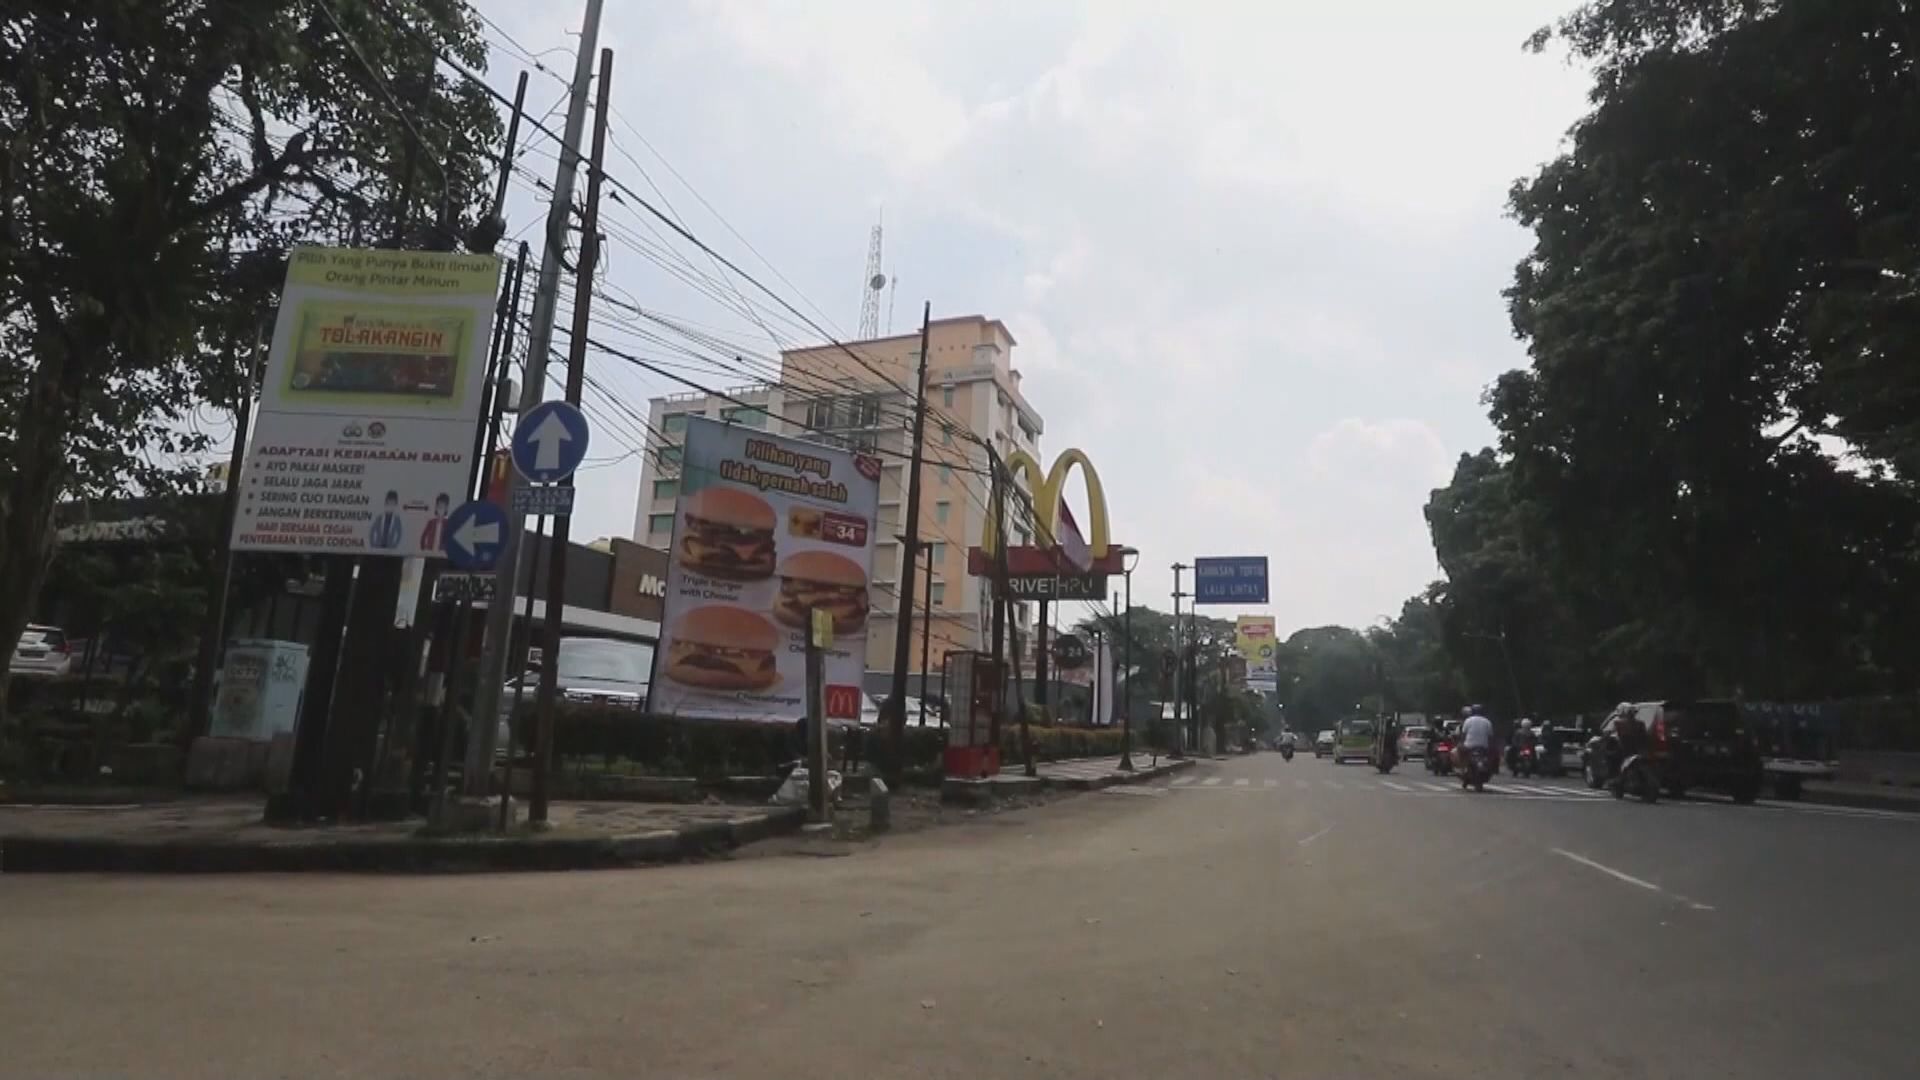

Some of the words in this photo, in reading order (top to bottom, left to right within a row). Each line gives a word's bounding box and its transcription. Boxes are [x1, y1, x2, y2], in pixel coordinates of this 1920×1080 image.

[297, 252, 326, 263] Pilih
[331, 254, 362, 268] Yang
[366, 257, 407, 271] Punya
[412, 258, 445, 271] Bukti
[326, 270, 366, 285] Orang
[369, 274, 411, 286] Pintar
[413, 275, 459, 288] Minum
[258, 446, 329, 457] ADAPTASI
[333, 449, 418, 461] KEBIASAAN
[422, 452, 462, 464] BARU
[266, 462, 287, 472] AYO
[290, 462, 319, 474] PAKAI
[796, 455, 831, 478] yang
[264, 477, 299, 488] SELALU
[302, 478, 328, 489] JAGA
[331, 479, 363, 490] JARAK
[720, 460, 759, 482] tidak
[758, 473, 810, 495] pernah
[810, 480, 848, 503] salah
[260, 492, 298, 504] SERING
[300, 493, 324, 504] CUCI
[326, 494, 370, 506] TANGAN
[257, 507, 303, 519] JANGAN
[303, 508, 373, 521] BERKERUMUN
[836, 525, 855, 541] 34
[299, 536, 325, 547] VIRUS
[326, 537, 365, 548] CORONA
[680, 588, 701, 598] with
[1009, 578, 1092, 595] RIVETHRU
